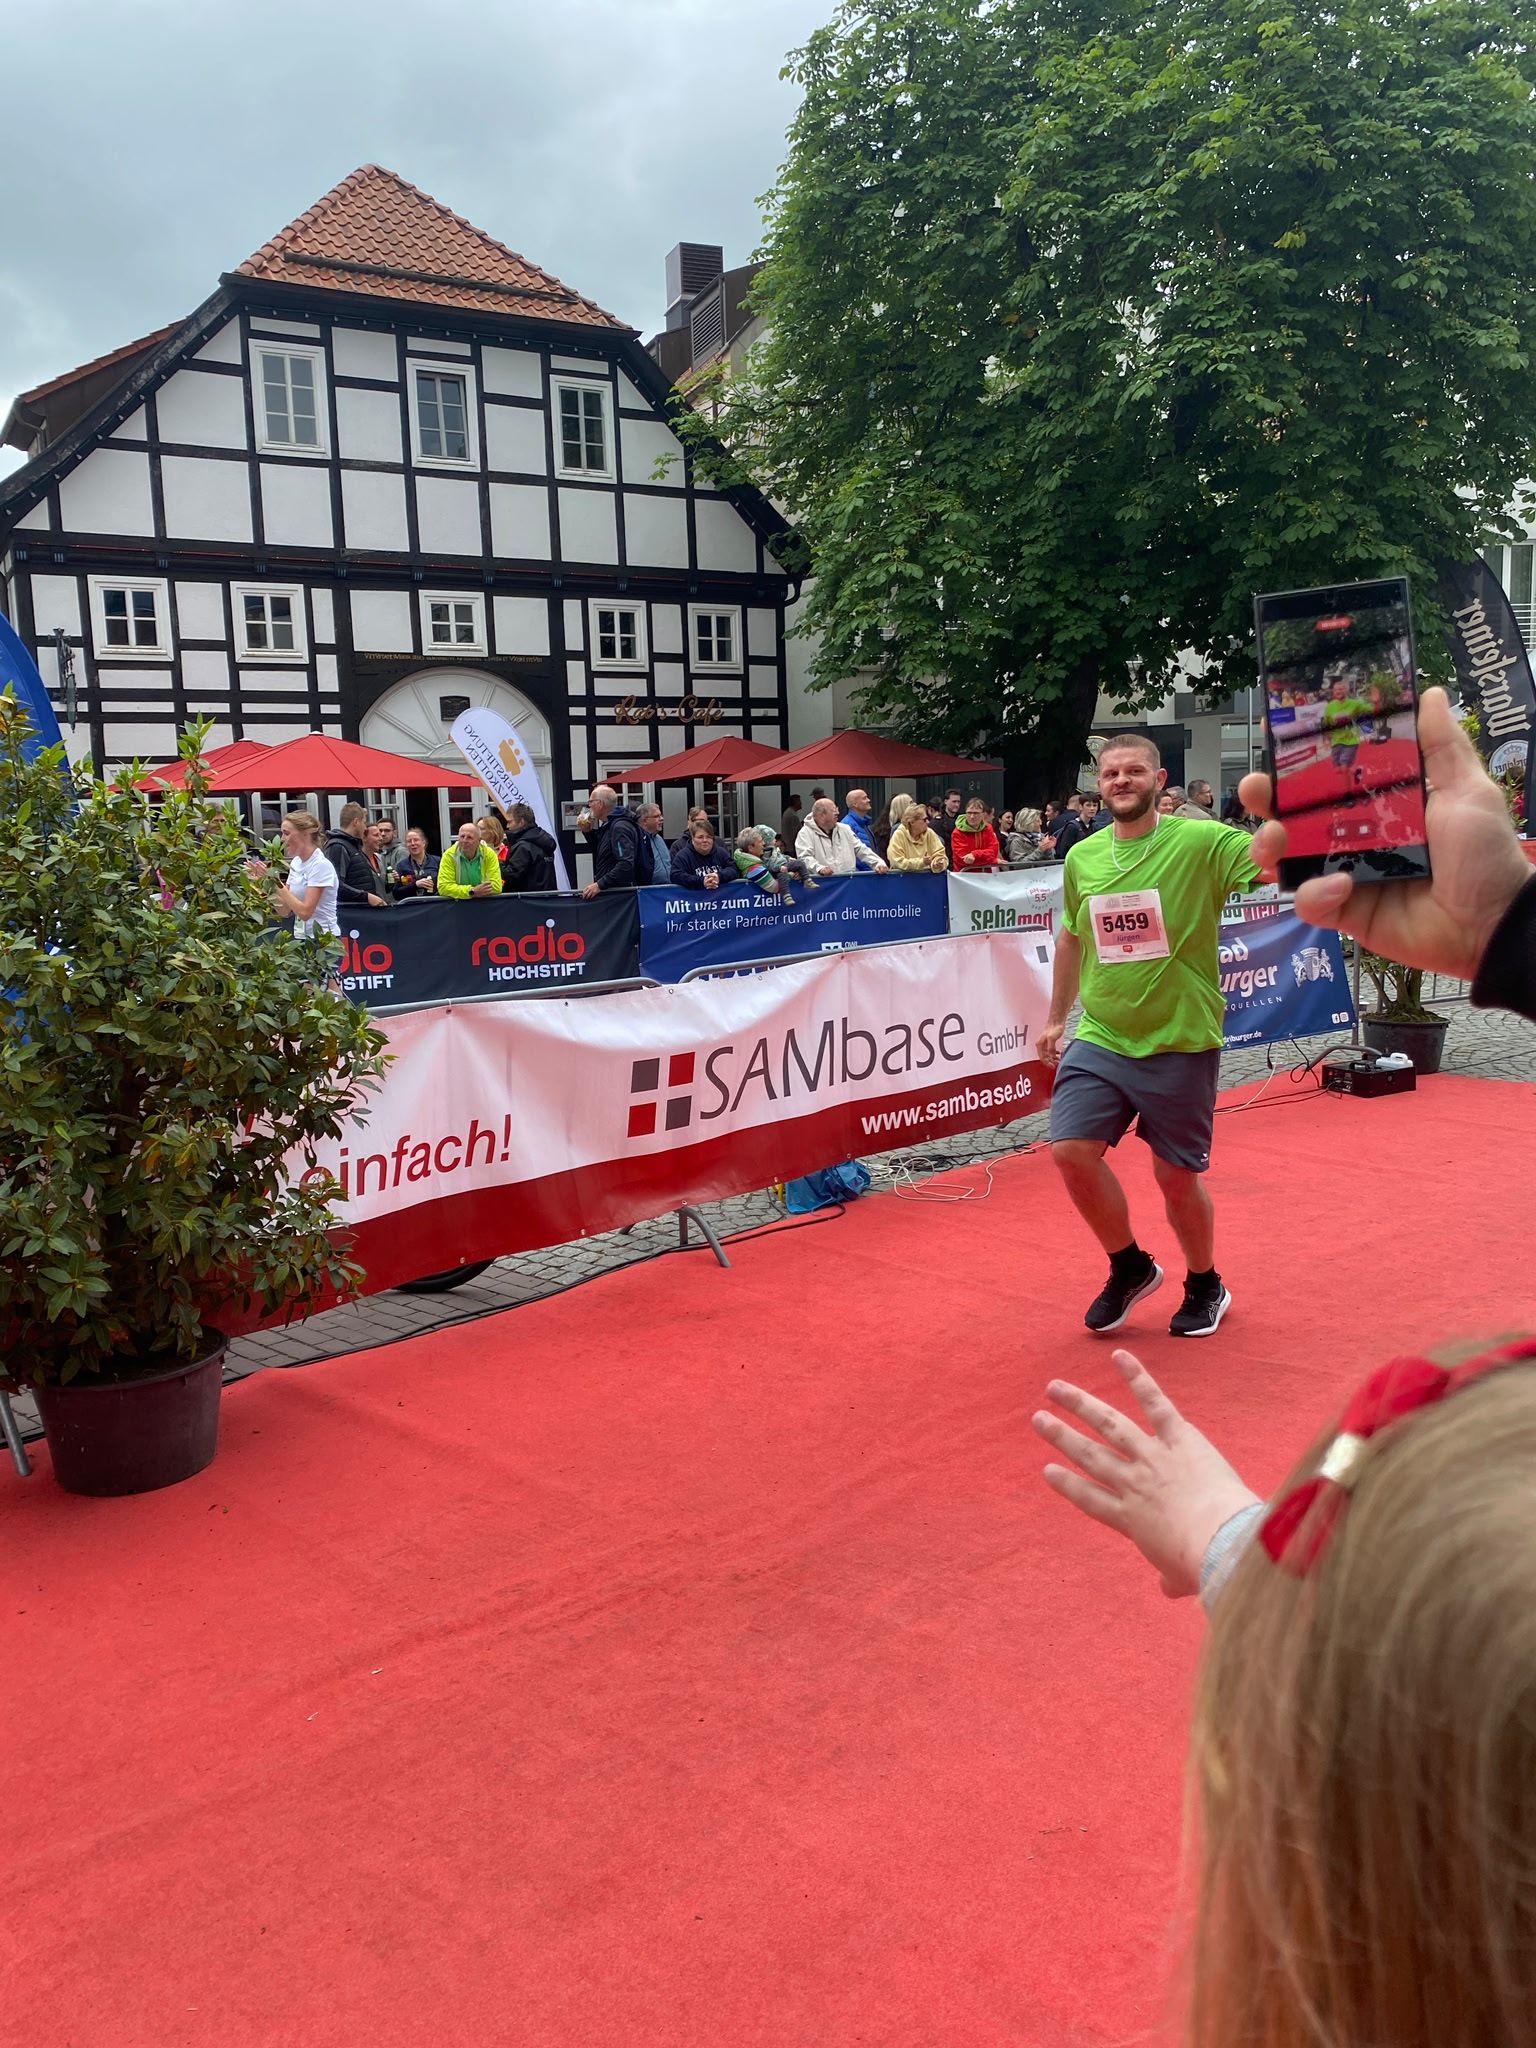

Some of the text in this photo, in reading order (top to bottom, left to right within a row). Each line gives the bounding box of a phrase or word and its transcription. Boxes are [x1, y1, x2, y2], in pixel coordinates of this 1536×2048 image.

[665, 893, 782, 915] Mit uns zum Ziel!
[666, 904, 922, 933] Ihr starker Partner rund um die Immobilie
[1102, 912, 1149, 933] 5459
[471, 918, 586, 966] radio
[1218, 936, 1249, 964] ad
[343, 974, 394, 991] STIFT
[488, 962, 586, 982] HOCHSTIFT
[1219, 965, 1278, 998] urger
[699, 1012, 1029, 1121] SAMbase GmbH
[861, 1074, 1032, 1136] www.sambase.de
[300, 1113, 512, 1200] einfach!
